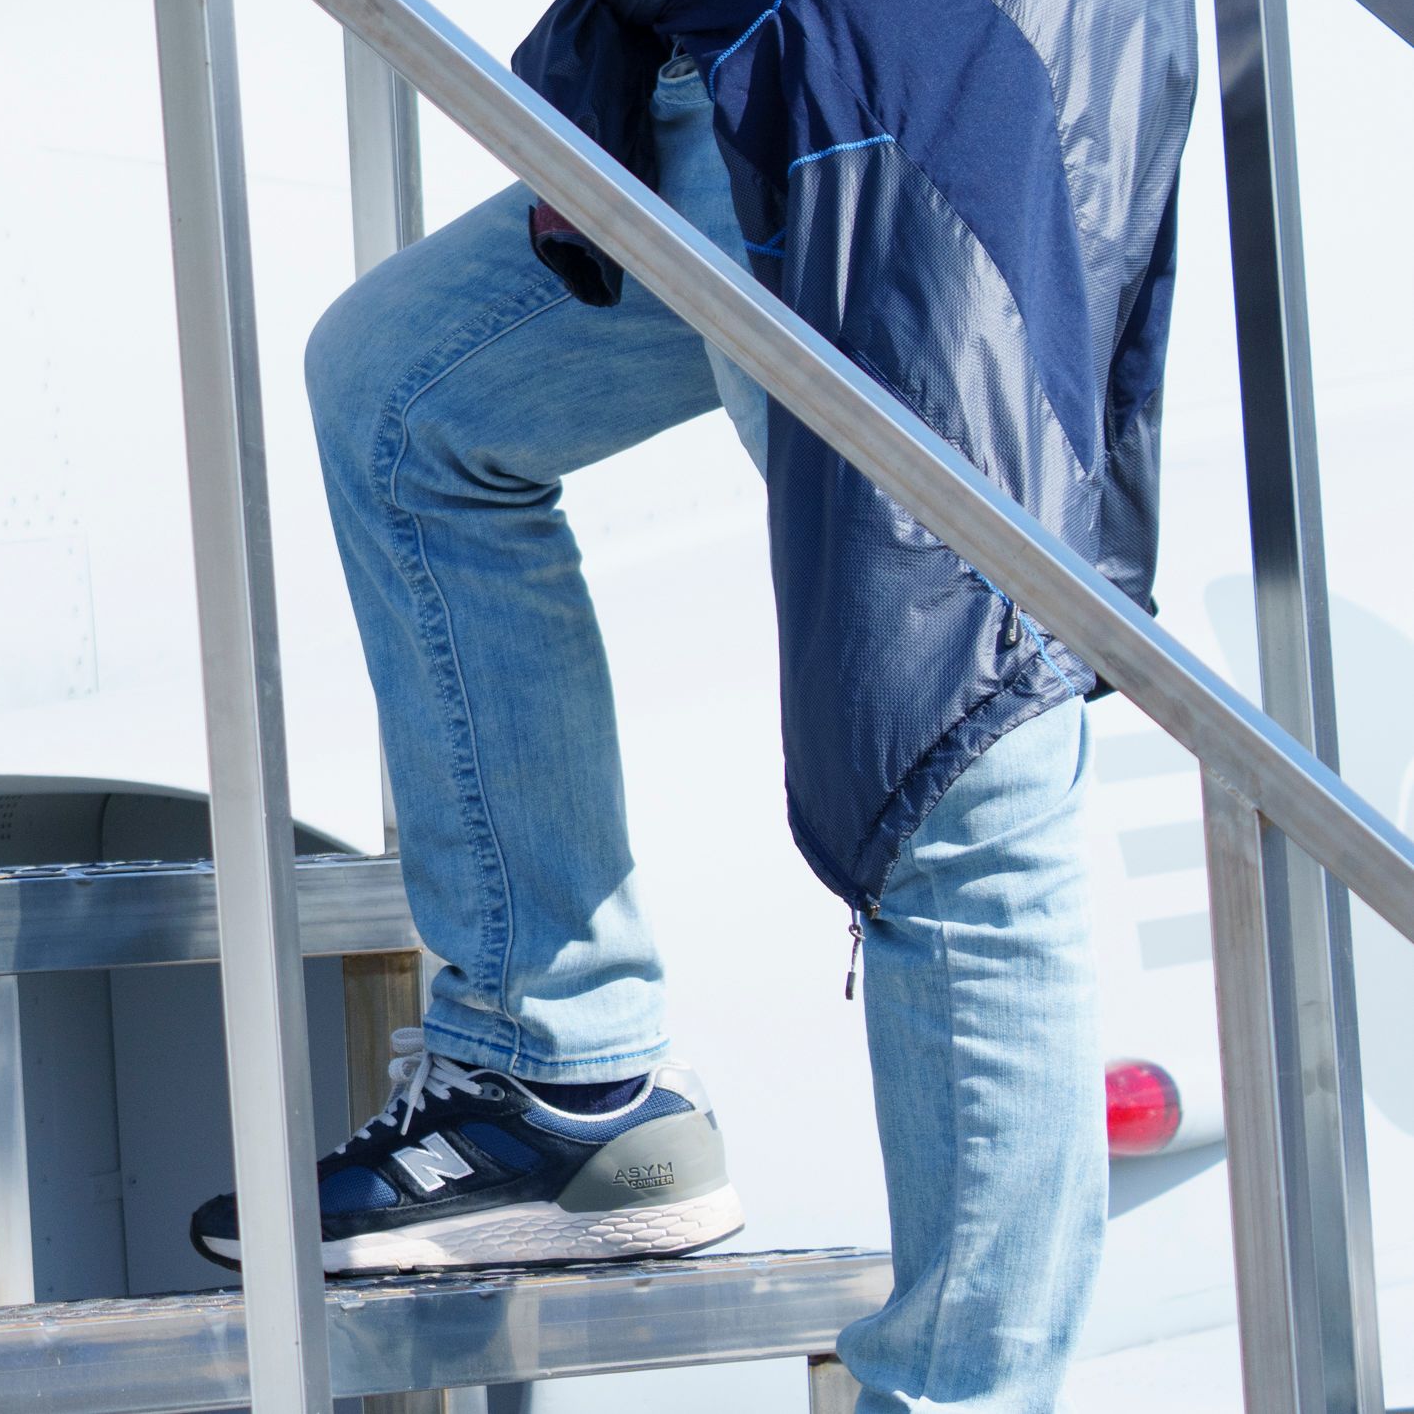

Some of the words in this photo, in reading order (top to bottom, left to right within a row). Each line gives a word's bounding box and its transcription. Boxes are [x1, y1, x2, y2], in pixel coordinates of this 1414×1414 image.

[391, 1132, 475, 1192] N
[613, 1161, 673, 1182] ASYM
[630, 1175, 674, 1189] COUNTER
